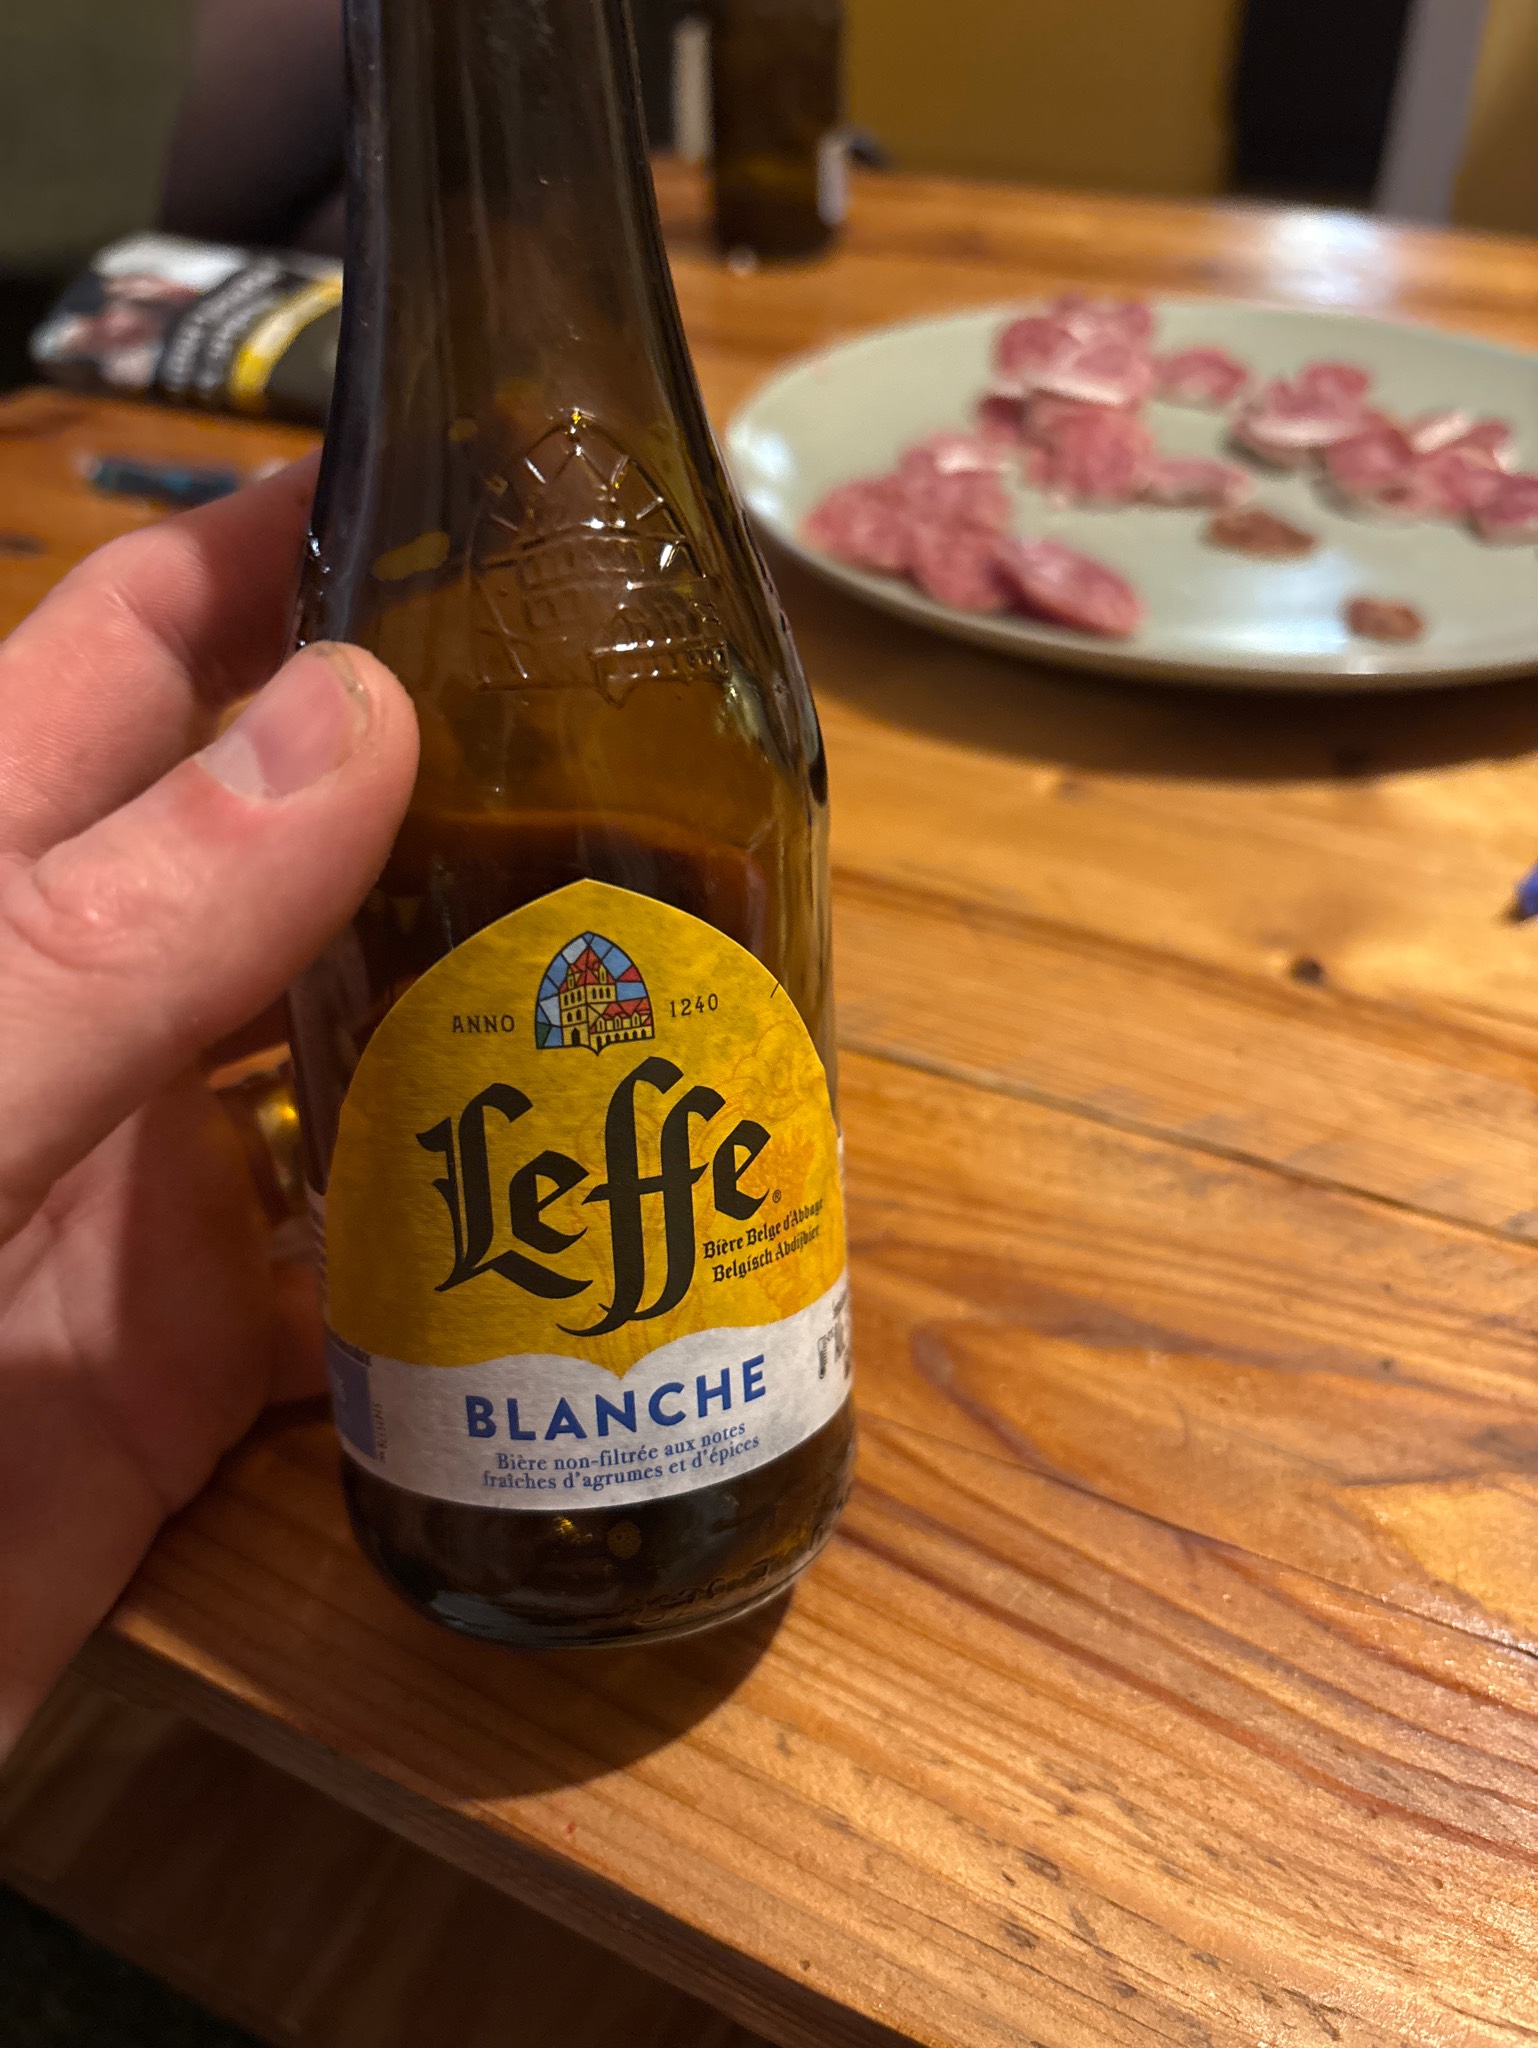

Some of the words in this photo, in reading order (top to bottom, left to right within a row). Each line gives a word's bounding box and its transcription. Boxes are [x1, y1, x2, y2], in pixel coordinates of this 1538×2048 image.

[451, 1014, 515, 1033] ANNO
[670, 993, 719, 1018] 1240
[415, 1056, 771, 1337] Leffe
[703, 1236, 743, 1259] Bière
[746, 1222, 781, 1246] Belge
[712, 1246, 773, 1282] Belgisch
[466, 1354, 766, 1440] BLANCHE
[496, 1453, 547, 1470] Bière
[554, 1444, 658, 1470] non-filtrée
[664, 1438, 696, 1457] aux
[701, 1422, 746, 1448] notes
[563, 1464, 663, 1491] d'agrumes
[669, 1459, 687, 1474] et
[692, 1435, 760, 1468] d'épices
